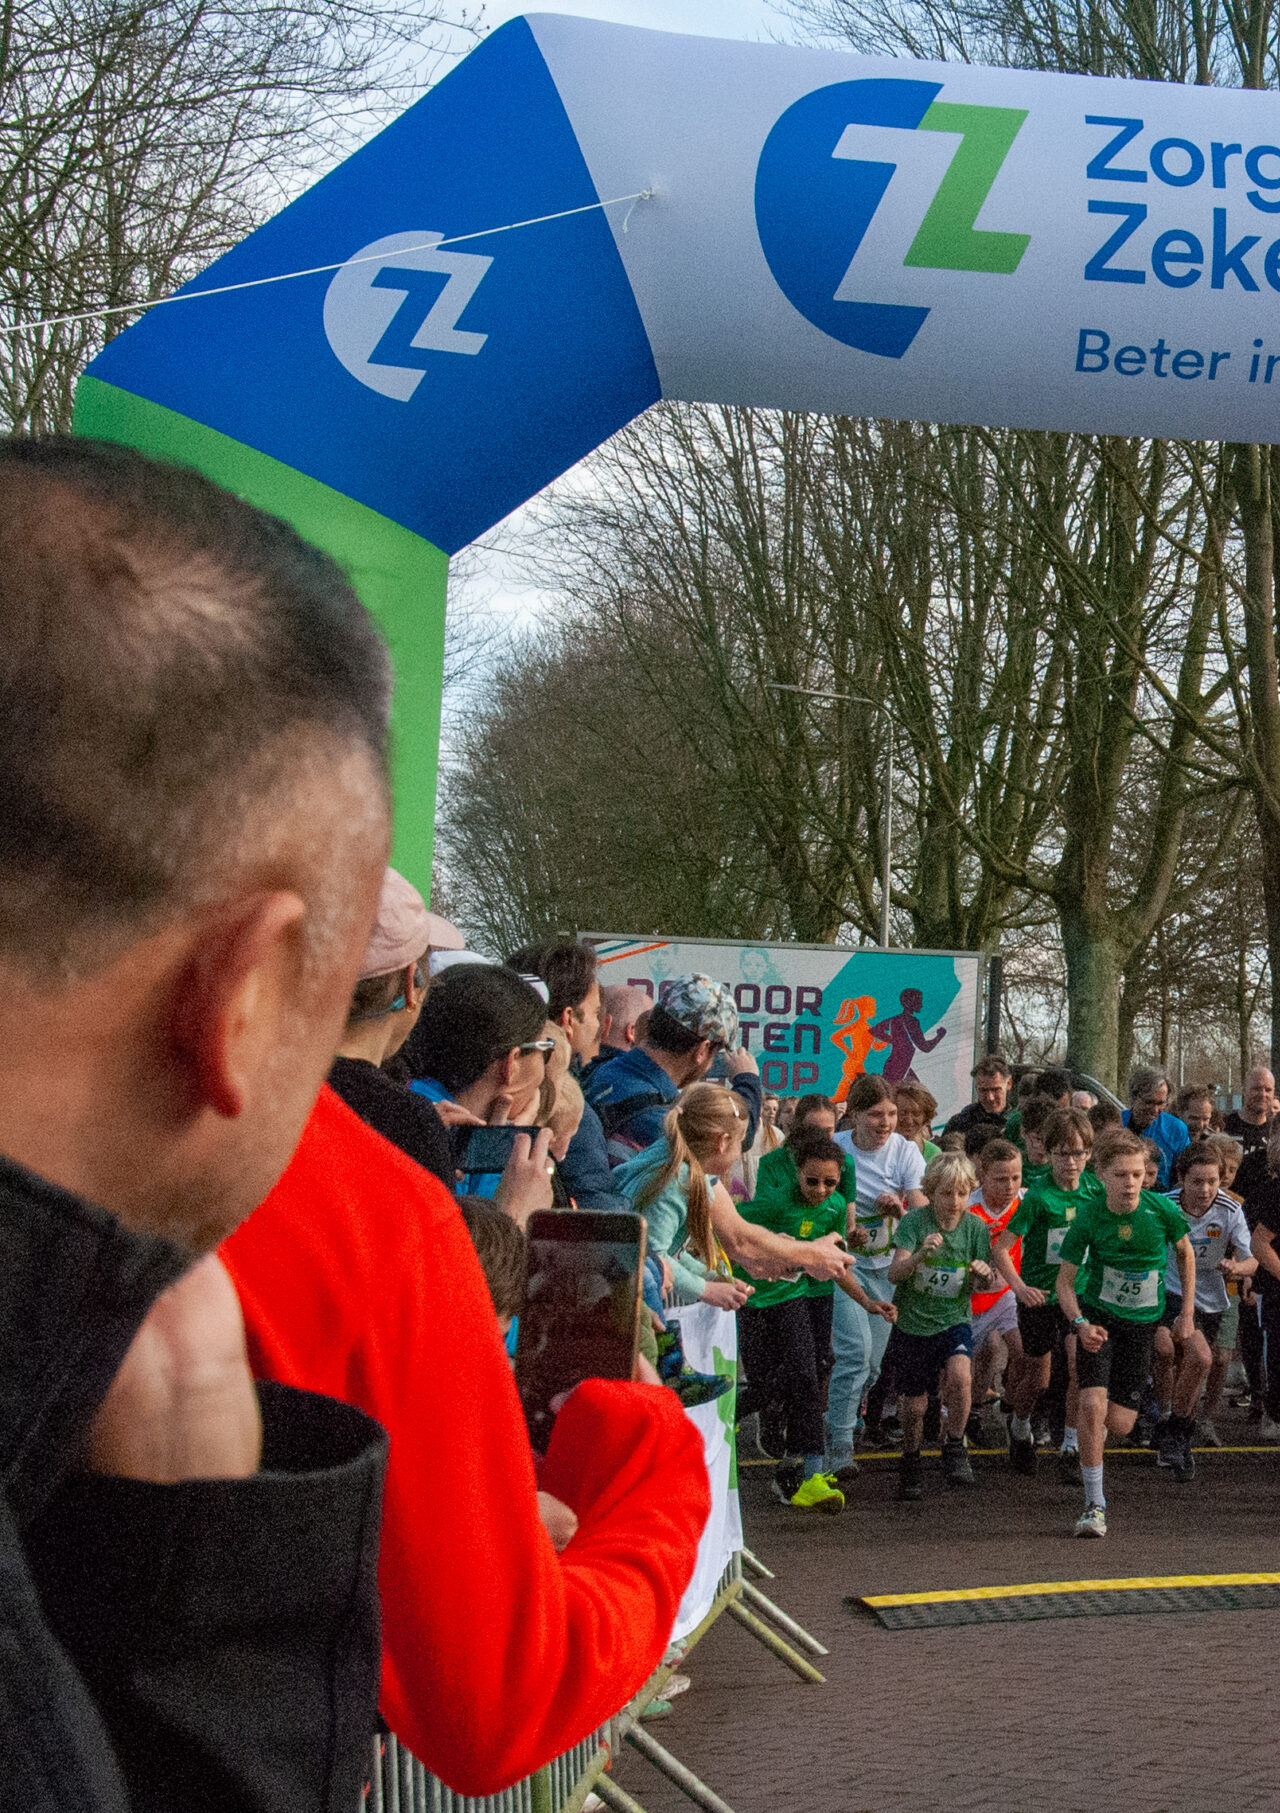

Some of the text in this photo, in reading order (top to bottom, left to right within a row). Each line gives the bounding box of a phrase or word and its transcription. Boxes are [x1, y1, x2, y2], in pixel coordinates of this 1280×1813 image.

[1075, 328, 1230, 380] Beter
[724, 983, 822, 1016] OOR
[737, 1021, 821, 1054] TEN
[762, 1060, 820, 1091] OP
[869, 1229, 878, 1242] 9
[928, 1272, 950, 1286] 49
[1120, 1282, 1142, 1295] 45
